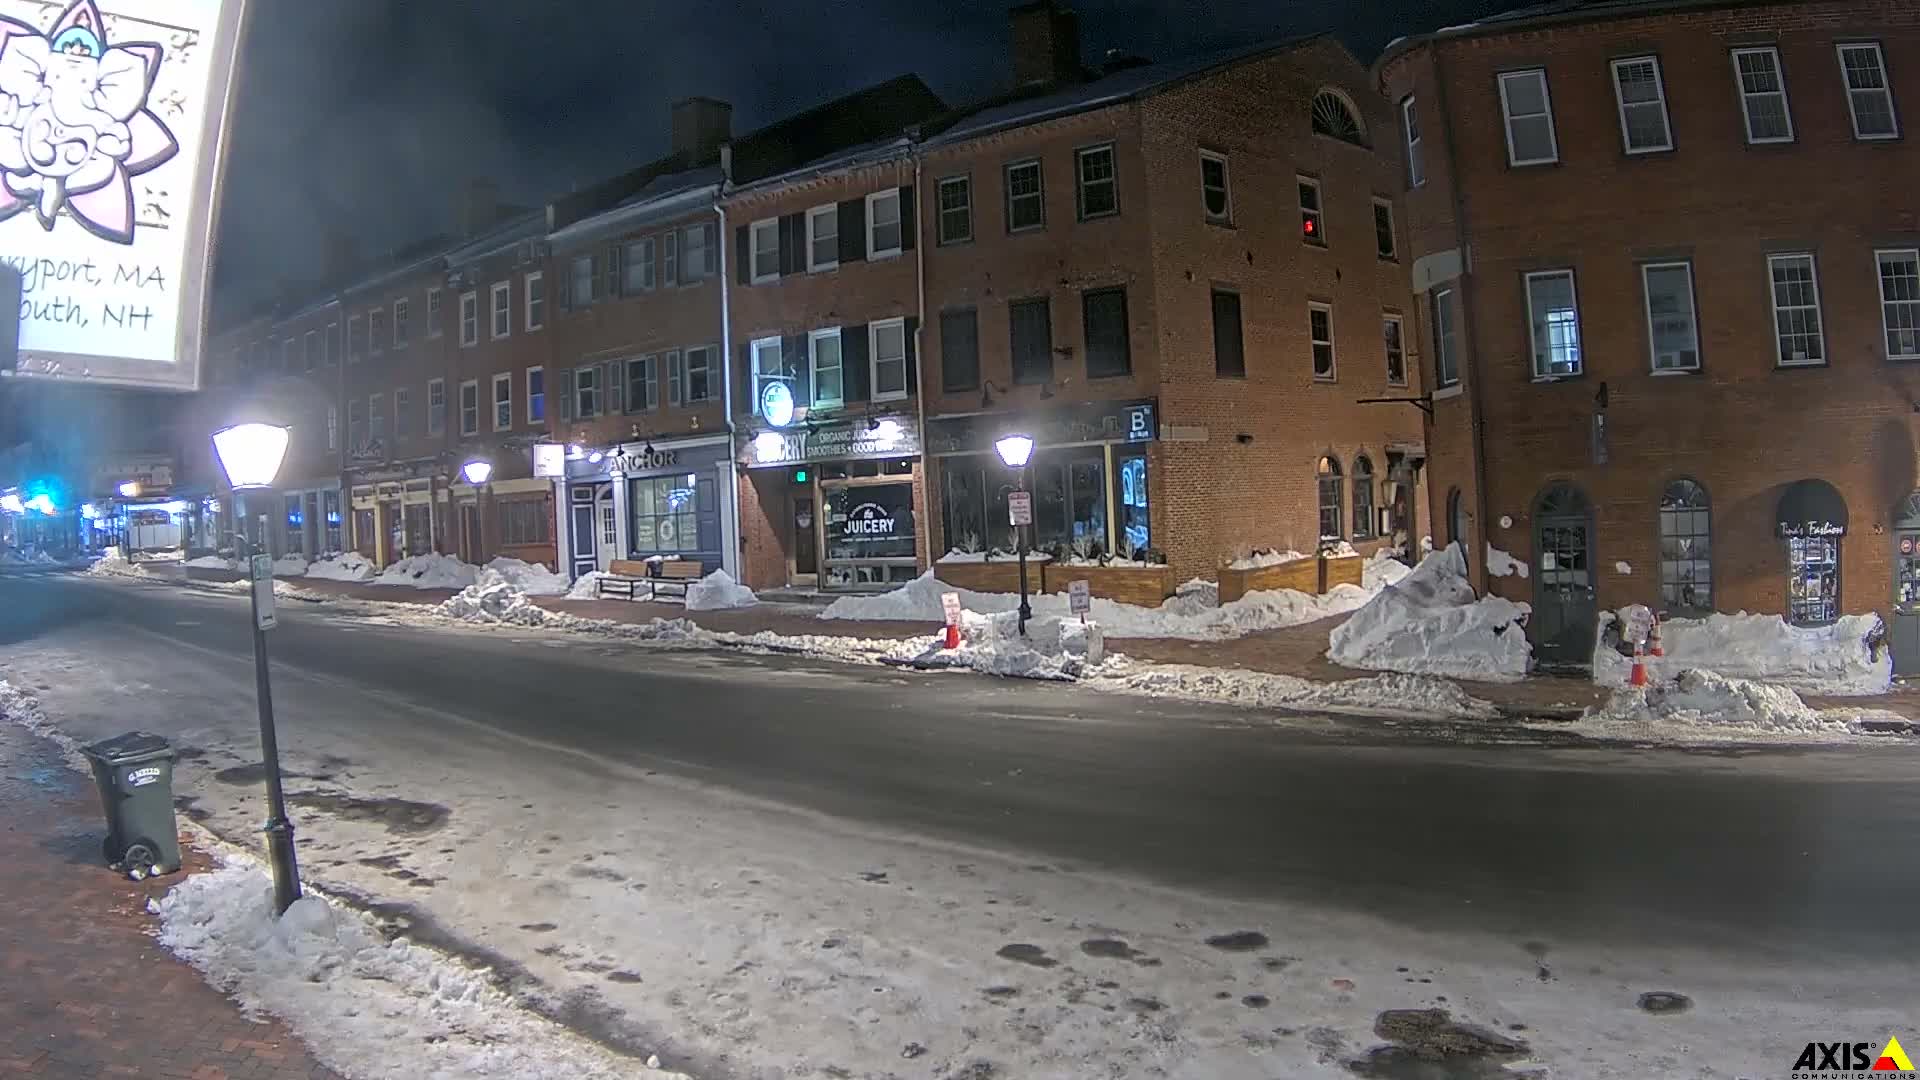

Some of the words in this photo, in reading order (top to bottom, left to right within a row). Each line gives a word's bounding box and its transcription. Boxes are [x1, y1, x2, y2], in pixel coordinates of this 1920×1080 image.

[113, 263, 166, 292] MA
[103, 304, 153, 331] NH
[818, 430, 850, 444] ORGANIC
[609, 449, 680, 471] ANCHOR
[807, 444, 846, 457] SMOOTHIES
[843, 518, 895, 534] JUICERY
